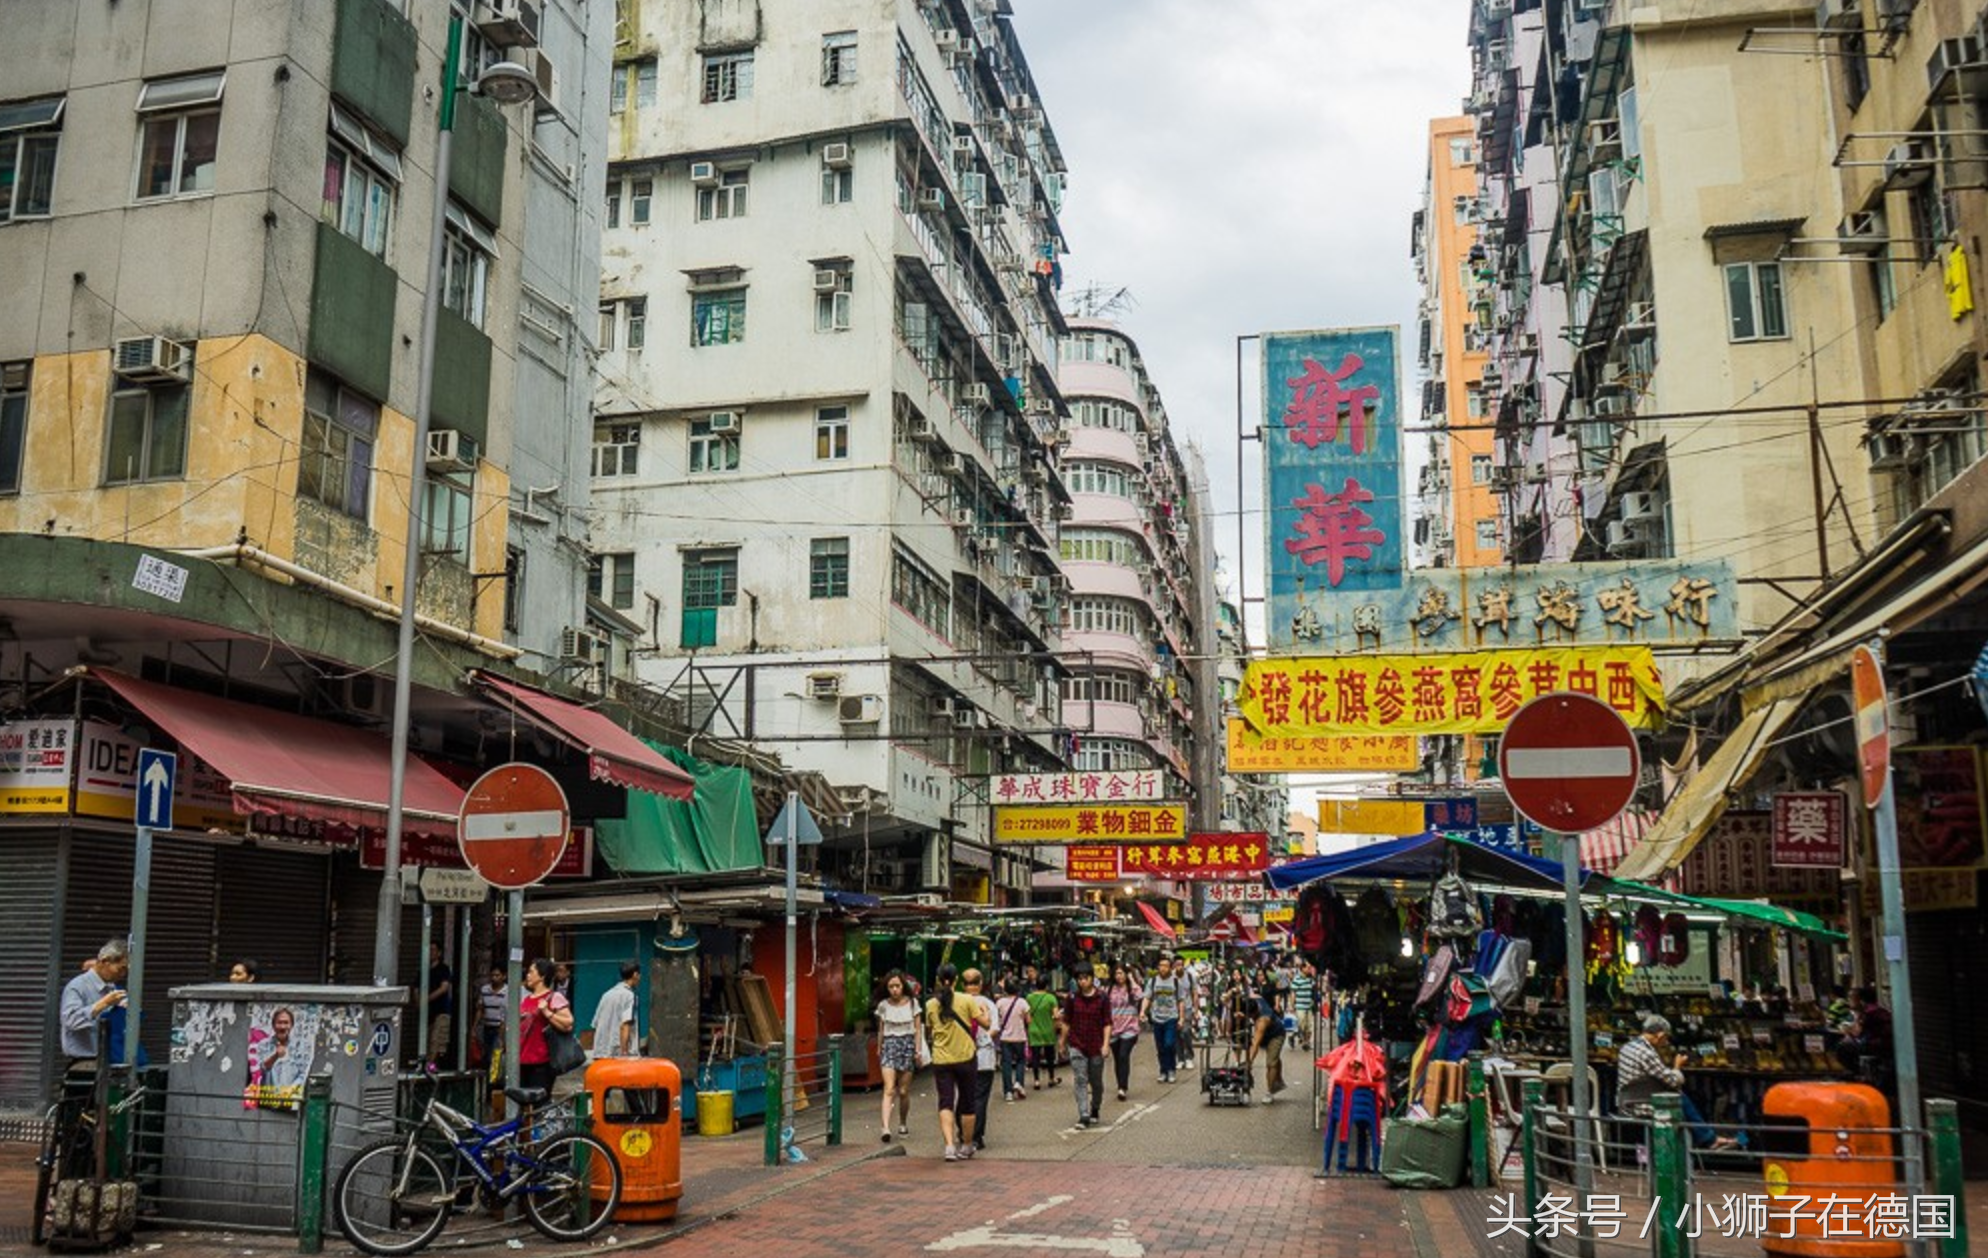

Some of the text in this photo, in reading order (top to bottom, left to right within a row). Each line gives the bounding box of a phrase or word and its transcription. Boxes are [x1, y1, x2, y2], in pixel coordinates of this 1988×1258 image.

[1284, 353, 1386, 588] 新華
[1248, 659, 1662, 726] 發花旗參燕窩參茸中西
[996, 773, 1157, 801] 華成珠寶金行
[1786, 798, 1829, 845] 藥
